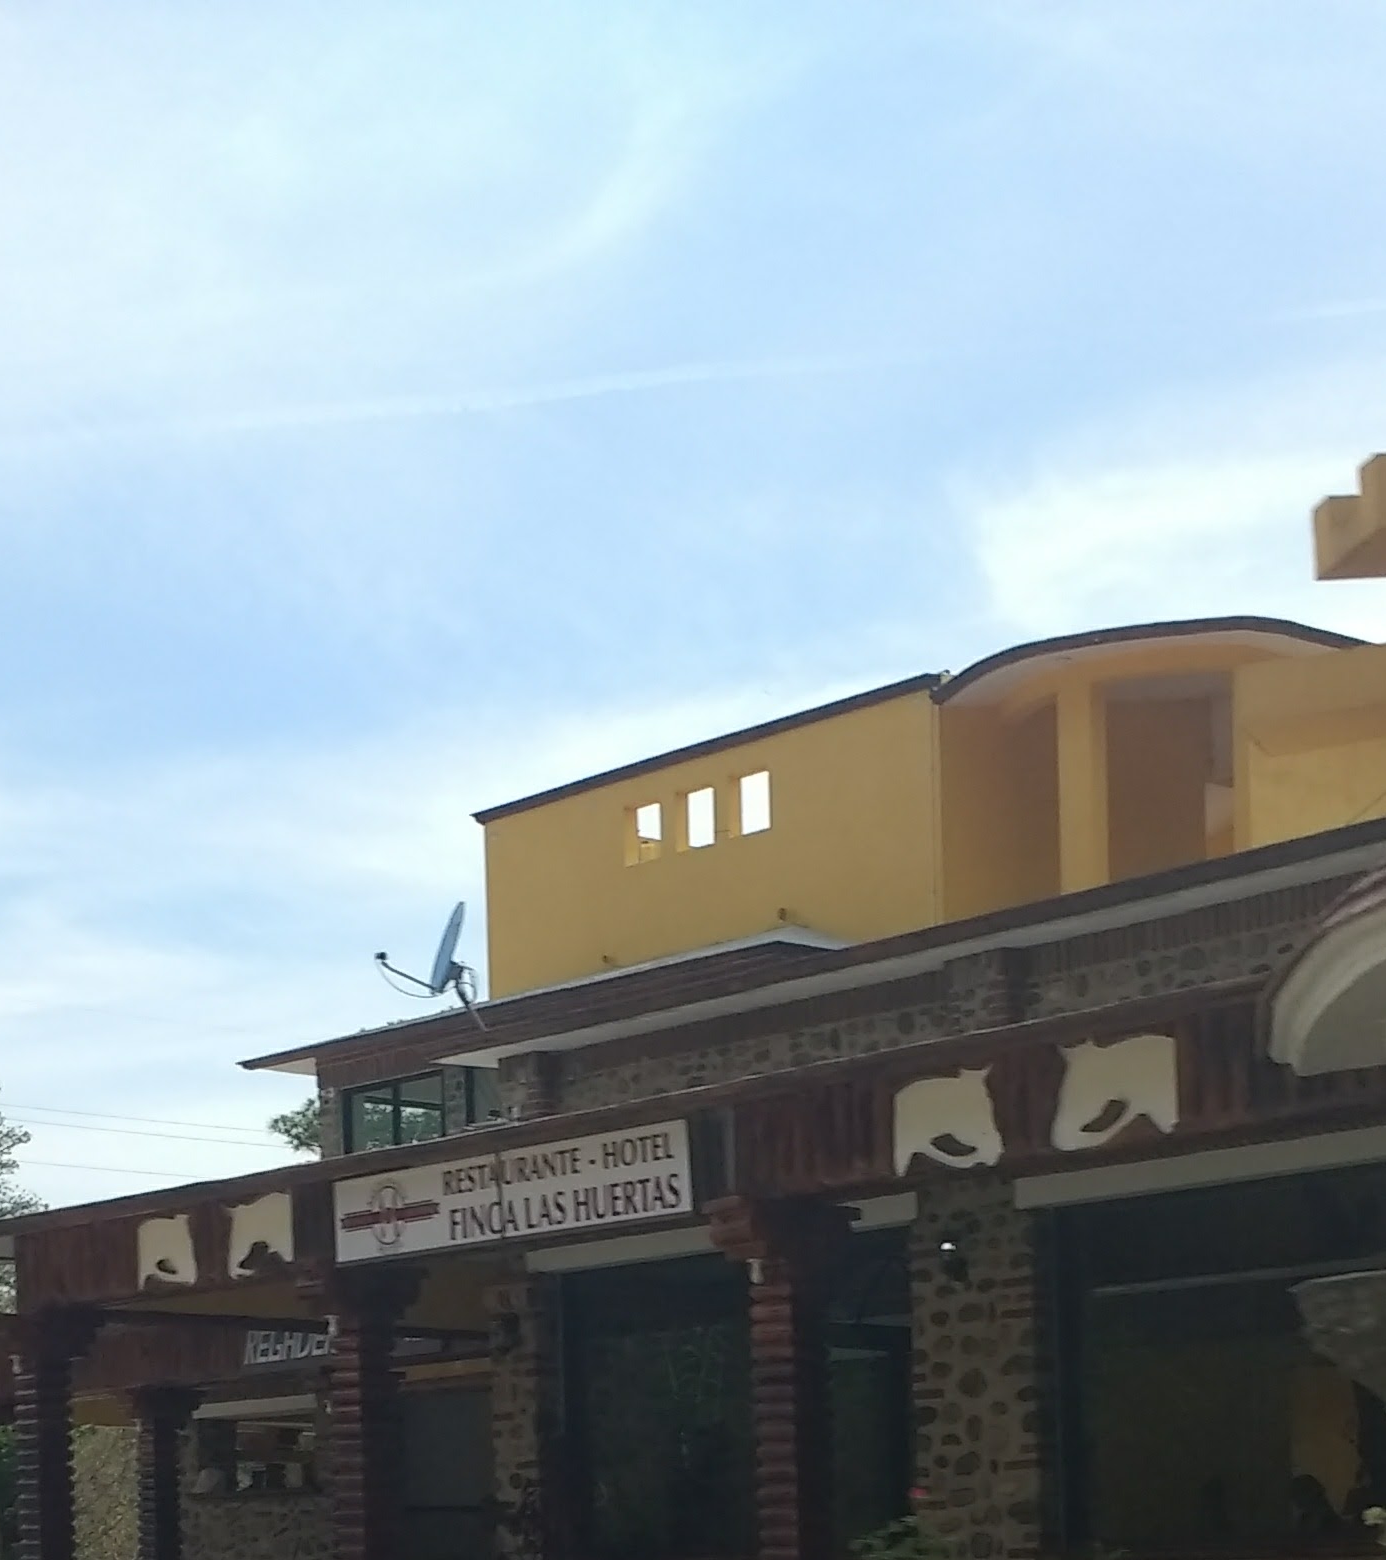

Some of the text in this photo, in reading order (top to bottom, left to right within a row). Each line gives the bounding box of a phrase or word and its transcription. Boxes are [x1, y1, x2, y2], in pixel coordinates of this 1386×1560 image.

[443, 1148, 581, 1196] RESTAURANTE
[602, 1132, 675, 1169] HOTEL
[449, 1173, 682, 1240] FINCA LAS HUERTAS
